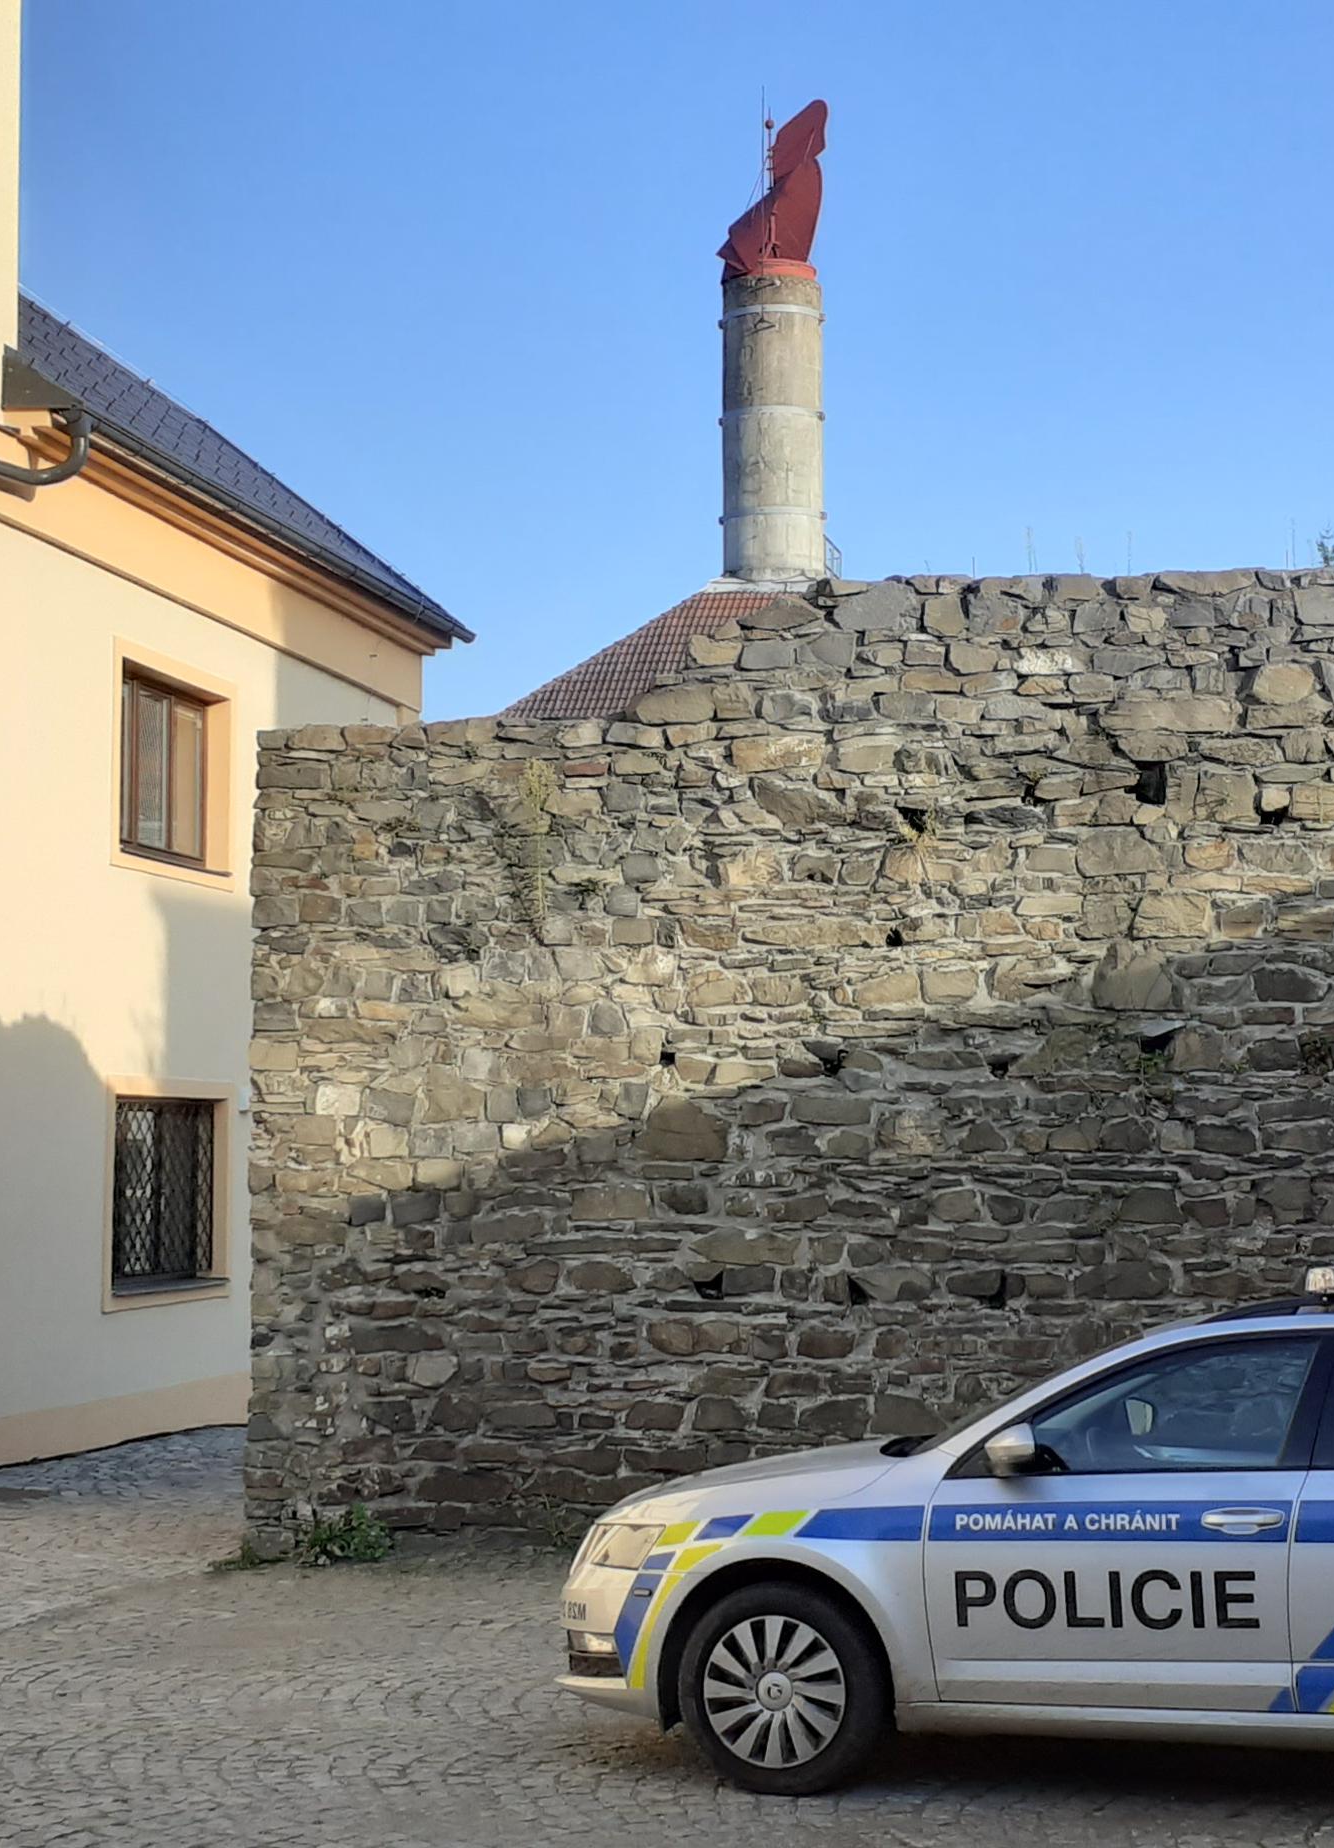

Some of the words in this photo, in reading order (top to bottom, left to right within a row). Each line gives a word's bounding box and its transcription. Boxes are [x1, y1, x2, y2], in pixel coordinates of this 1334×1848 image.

[955, 1509, 1056, 1531] POMÁHAT
[1063, 1513, 1079, 1531] A
[1085, 1509, 1180, 1531] CHRÁNIT
[954, 1569, 1260, 1630] POLICIE
